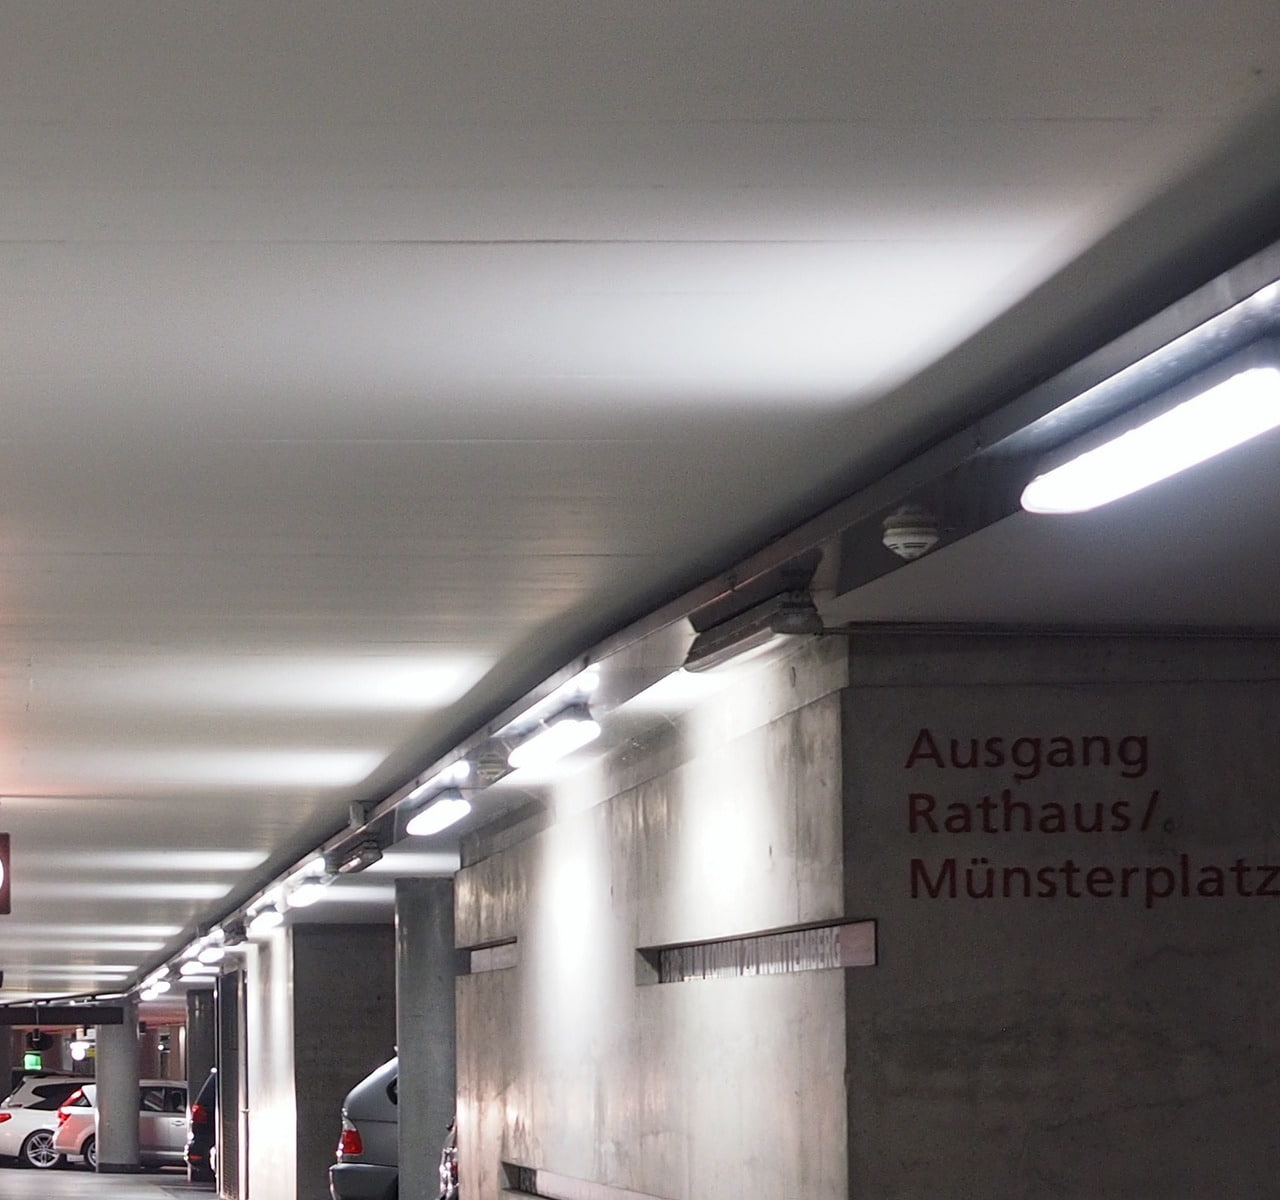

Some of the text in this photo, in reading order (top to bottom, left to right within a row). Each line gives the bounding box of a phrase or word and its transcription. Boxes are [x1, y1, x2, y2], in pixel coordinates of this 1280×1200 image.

[905, 728, 1149, 780] Ausgang
[908, 789, 1161, 834] Rathaus/
[910, 853, 1280, 908] Münsterplatz
